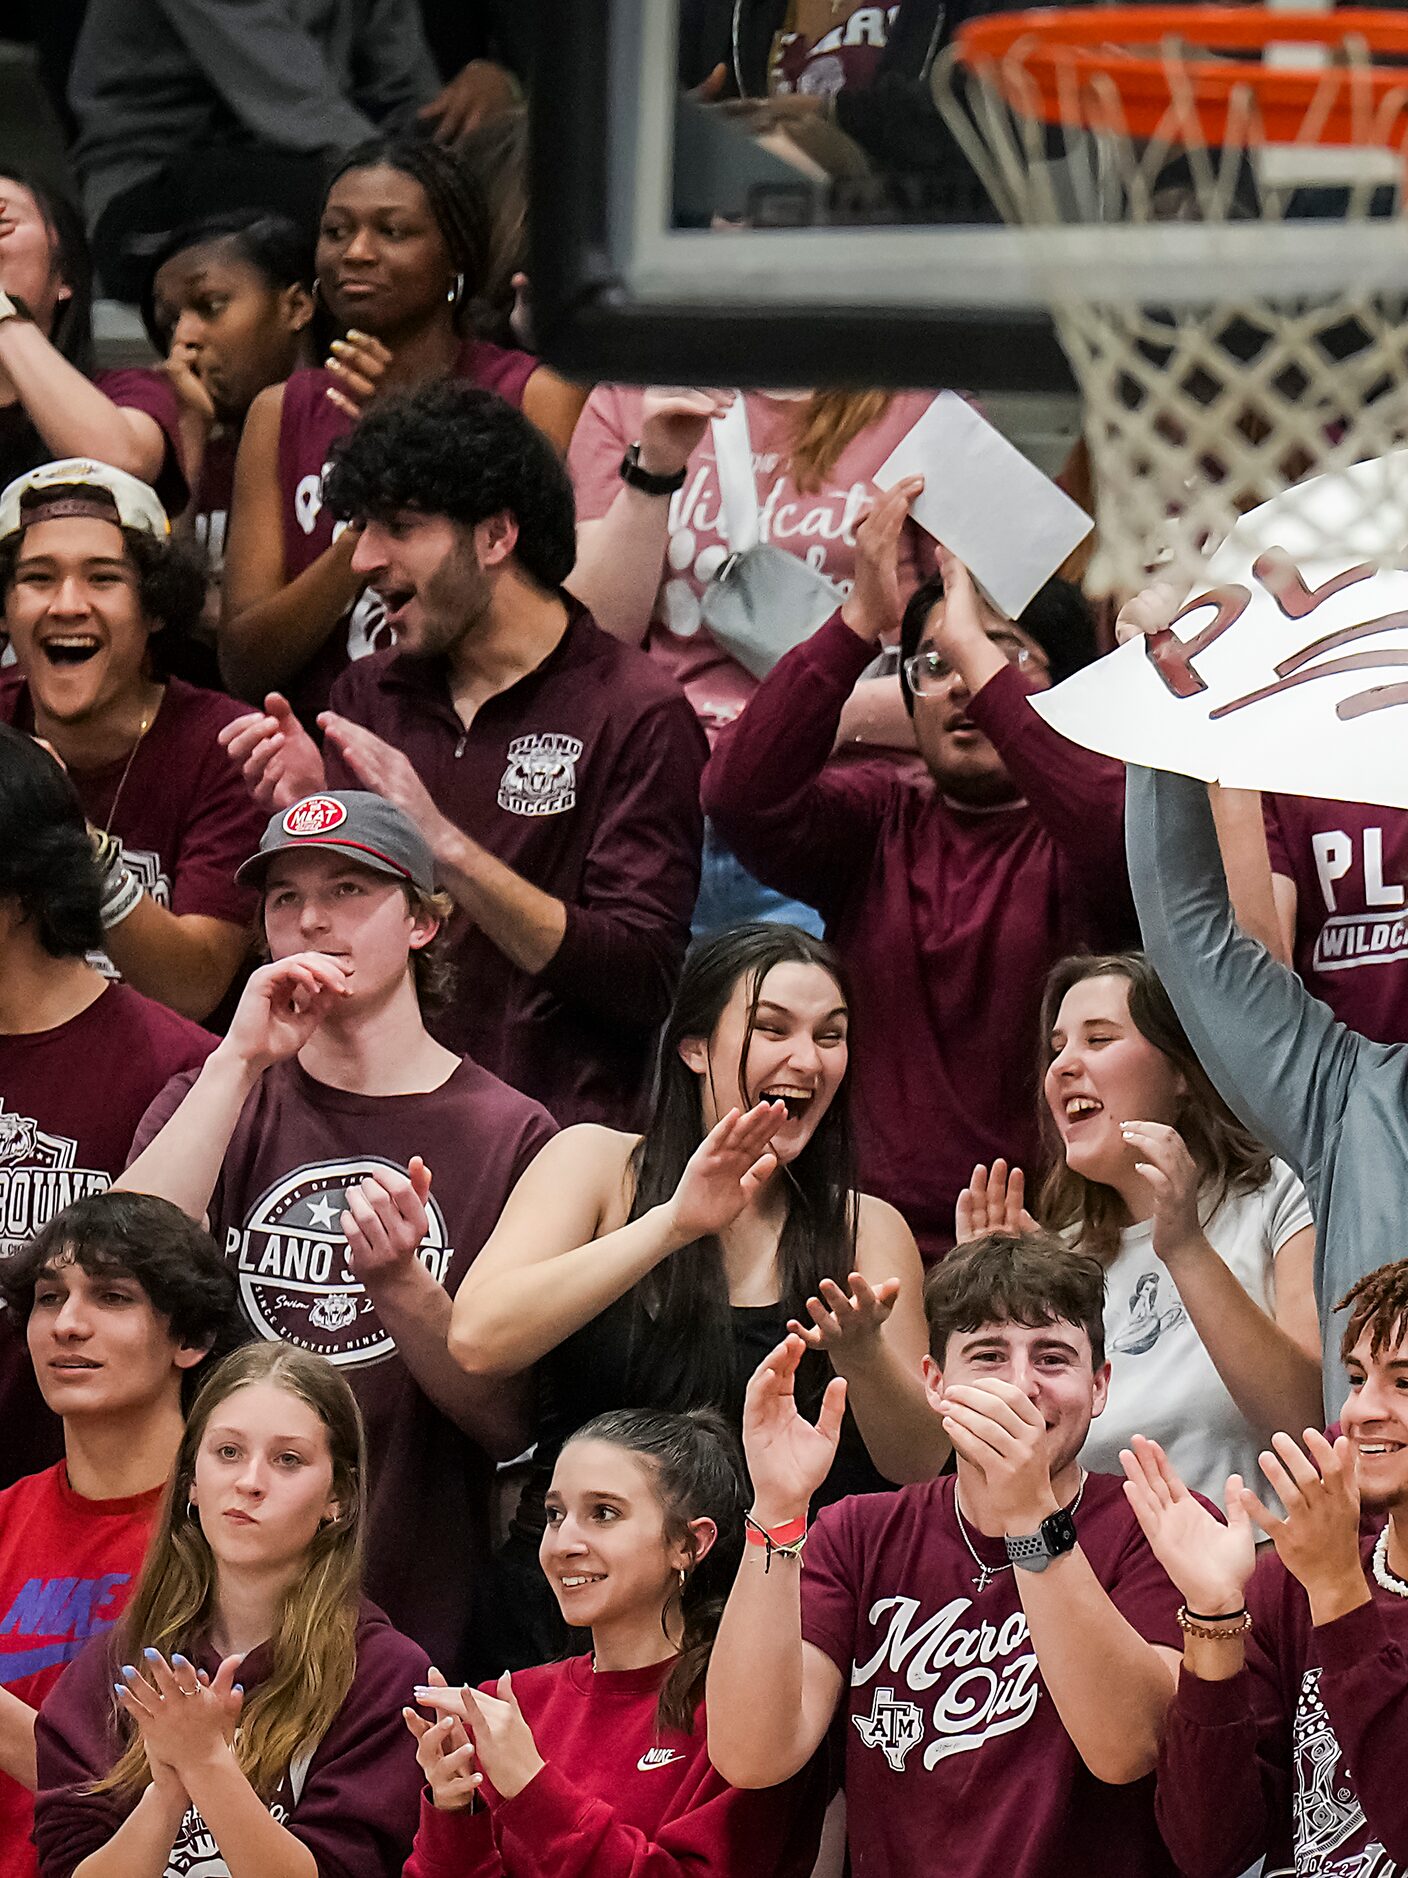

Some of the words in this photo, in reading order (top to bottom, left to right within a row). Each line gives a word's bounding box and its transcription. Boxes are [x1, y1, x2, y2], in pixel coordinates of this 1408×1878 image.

[509, 734, 583, 757] PLANO
[290, 809, 338, 827] MEAT
[267, 1190, 302, 1224] HOME
[310, 1180, 329, 1192] OF
[225, 1226, 334, 1283] PLANO
[254, 1285, 278, 1325] SINCE
[273, 1294, 310, 1310] Swim
[0, 1572, 132, 1638] NIKE
[644, 1747, 676, 1764] NIKE
